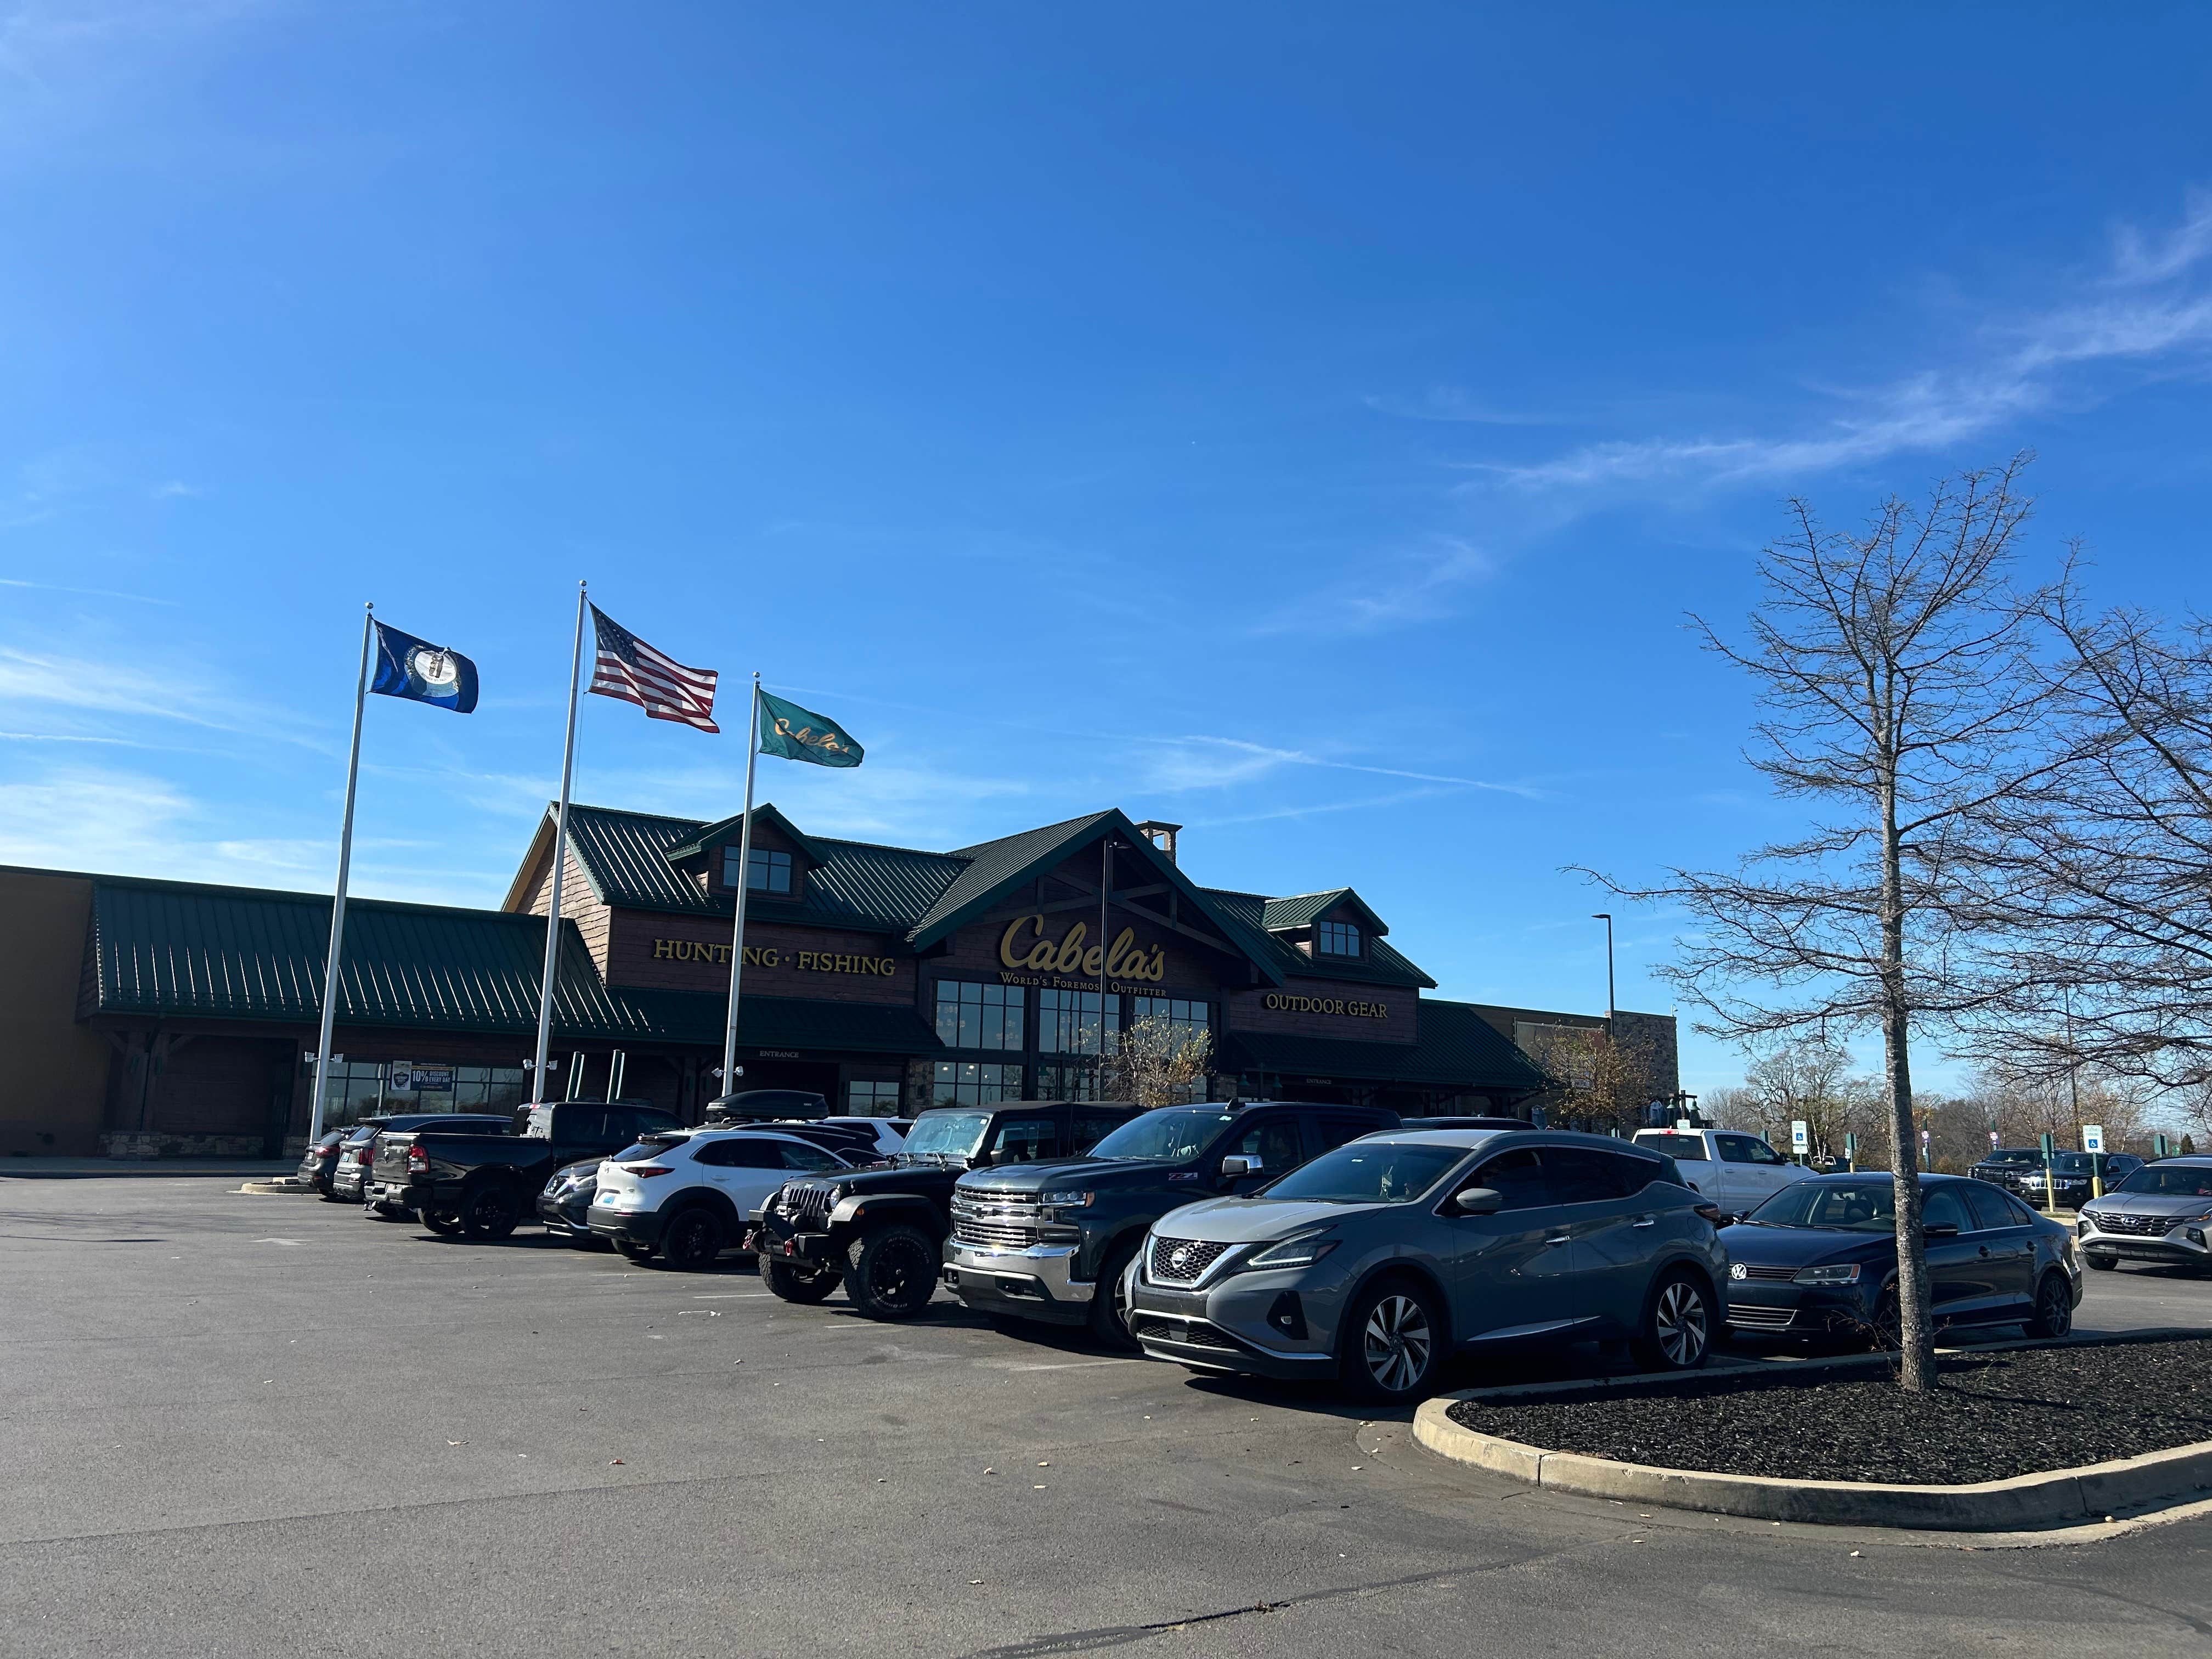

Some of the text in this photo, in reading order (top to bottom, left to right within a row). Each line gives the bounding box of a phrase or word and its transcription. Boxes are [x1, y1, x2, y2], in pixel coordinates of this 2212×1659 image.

[653, 939, 896, 977] HUNTNG FISHING
[1001, 914, 1165, 981] Cabela's
[1053, 976, 1106, 991] FOREMOS
[1111, 981, 1167, 997] OUTFITTER
[1266, 994, 1389, 1018] OUTDOOR GEAR
[759, 1050, 799, 1058] ENTRANCE
[413, 1070, 428, 1082] 10%
